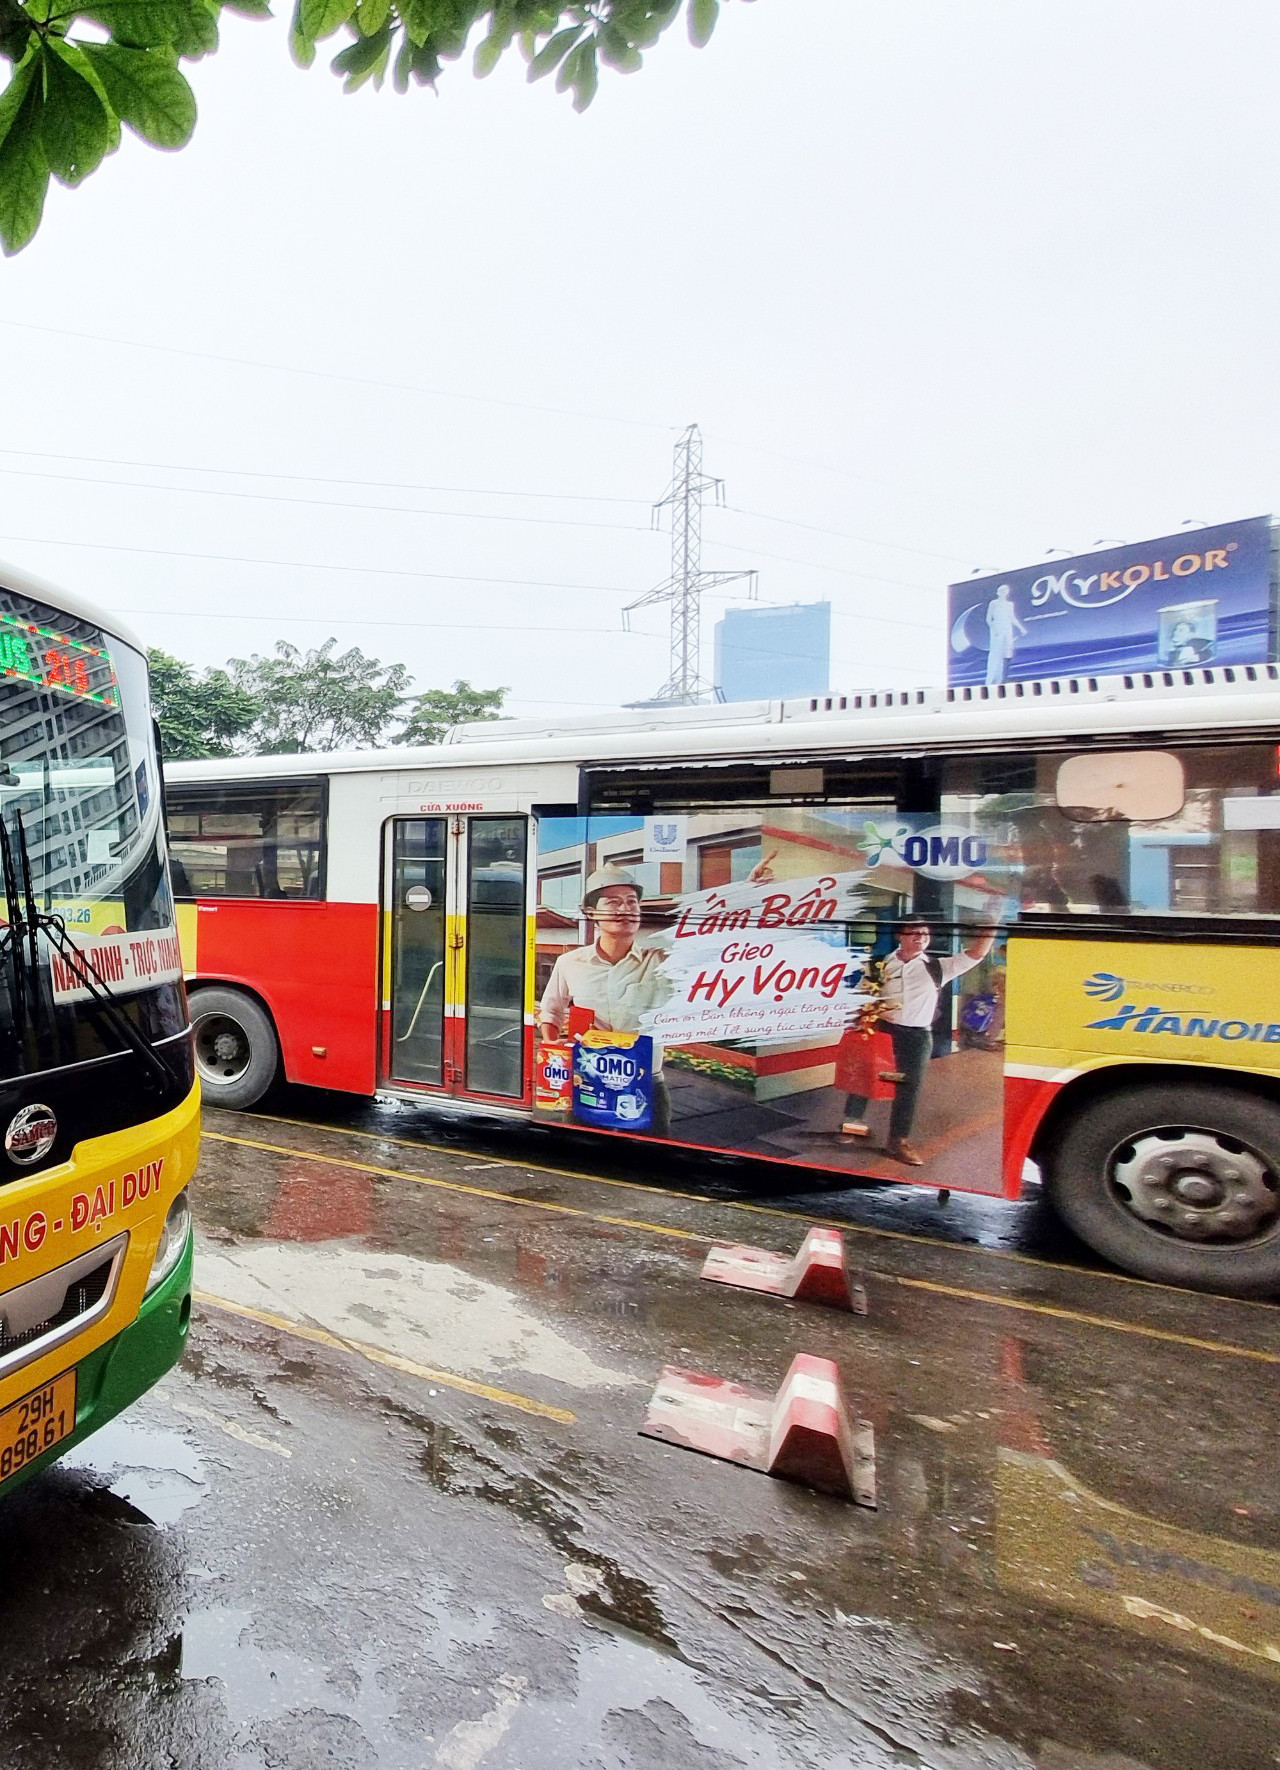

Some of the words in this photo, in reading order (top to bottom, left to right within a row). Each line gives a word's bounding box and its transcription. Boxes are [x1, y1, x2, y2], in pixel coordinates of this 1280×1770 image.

[904, 835, 987, 867] OMO
[758, 877, 839, 929] Bẩn
[52, 949, 89, 992] NAM
[129, 937, 157, 981] TRỰC
[158, 936, 180, 971] NINH
[720, 942, 774, 964] Gieo
[687, 968, 746, 1008] Hy
[753, 960, 847, 1002] Vọng
[1125, 981, 1216, 995] TRANSERCO
[544, 1066, 569, 1081] OMO
[596, 1056, 635, 1078] OMO
[601, 1074, 630, 1083] MATIC
[70, 1181, 115, 1235] ĐẠI
[121, 1157, 166, 1209] DUY
[17, 1385, 55, 1435] 29H
[0, 1409, 66, 1478] 898.61
